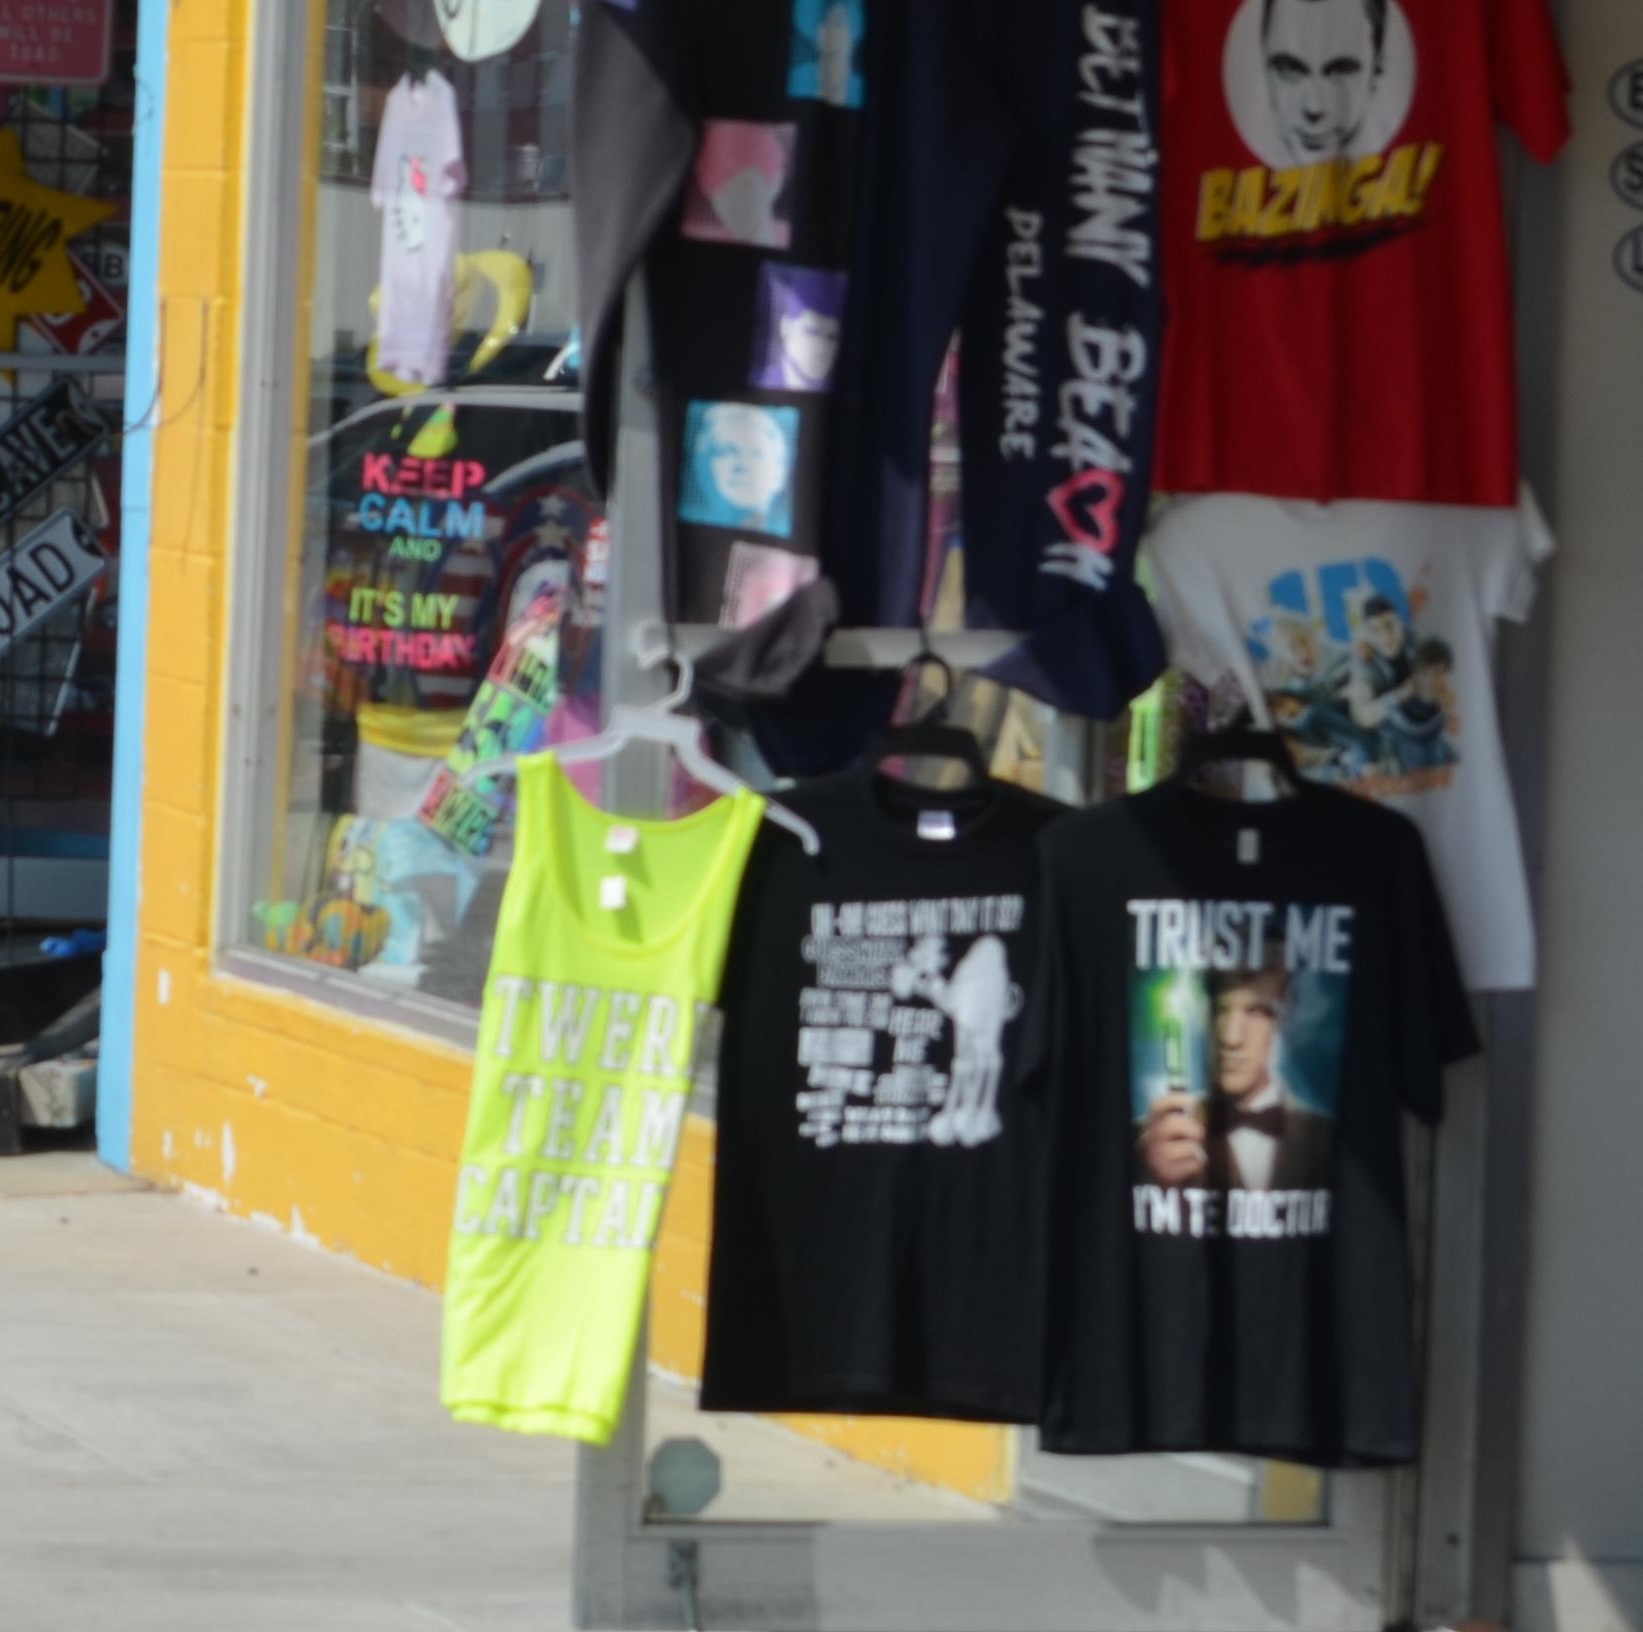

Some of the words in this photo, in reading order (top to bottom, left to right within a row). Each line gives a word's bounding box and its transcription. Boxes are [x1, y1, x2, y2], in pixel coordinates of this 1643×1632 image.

[1065, 3, 1158, 287] BETHANY
[1195, 143, 1442, 242] BAZINGA!
[1000, 206, 1044, 462] DELAWARE
[361, 452, 486, 499] KEEP
[359, 493, 485, 539] CALM
[389, 536, 443, 563] AND
[326, 624, 477, 669] BIRTHDAY
[350, 588, 406, 628] IT'S
[411, 593, 459, 629] MY
[1127, 898, 1273, 971] TRUST
[1283, 902, 1355, 972] ME
[494, 974, 700, 1078] TWER
[502, 1071, 686, 1171] TEAM
[455, 1165, 662, 1249] CAPTAI
